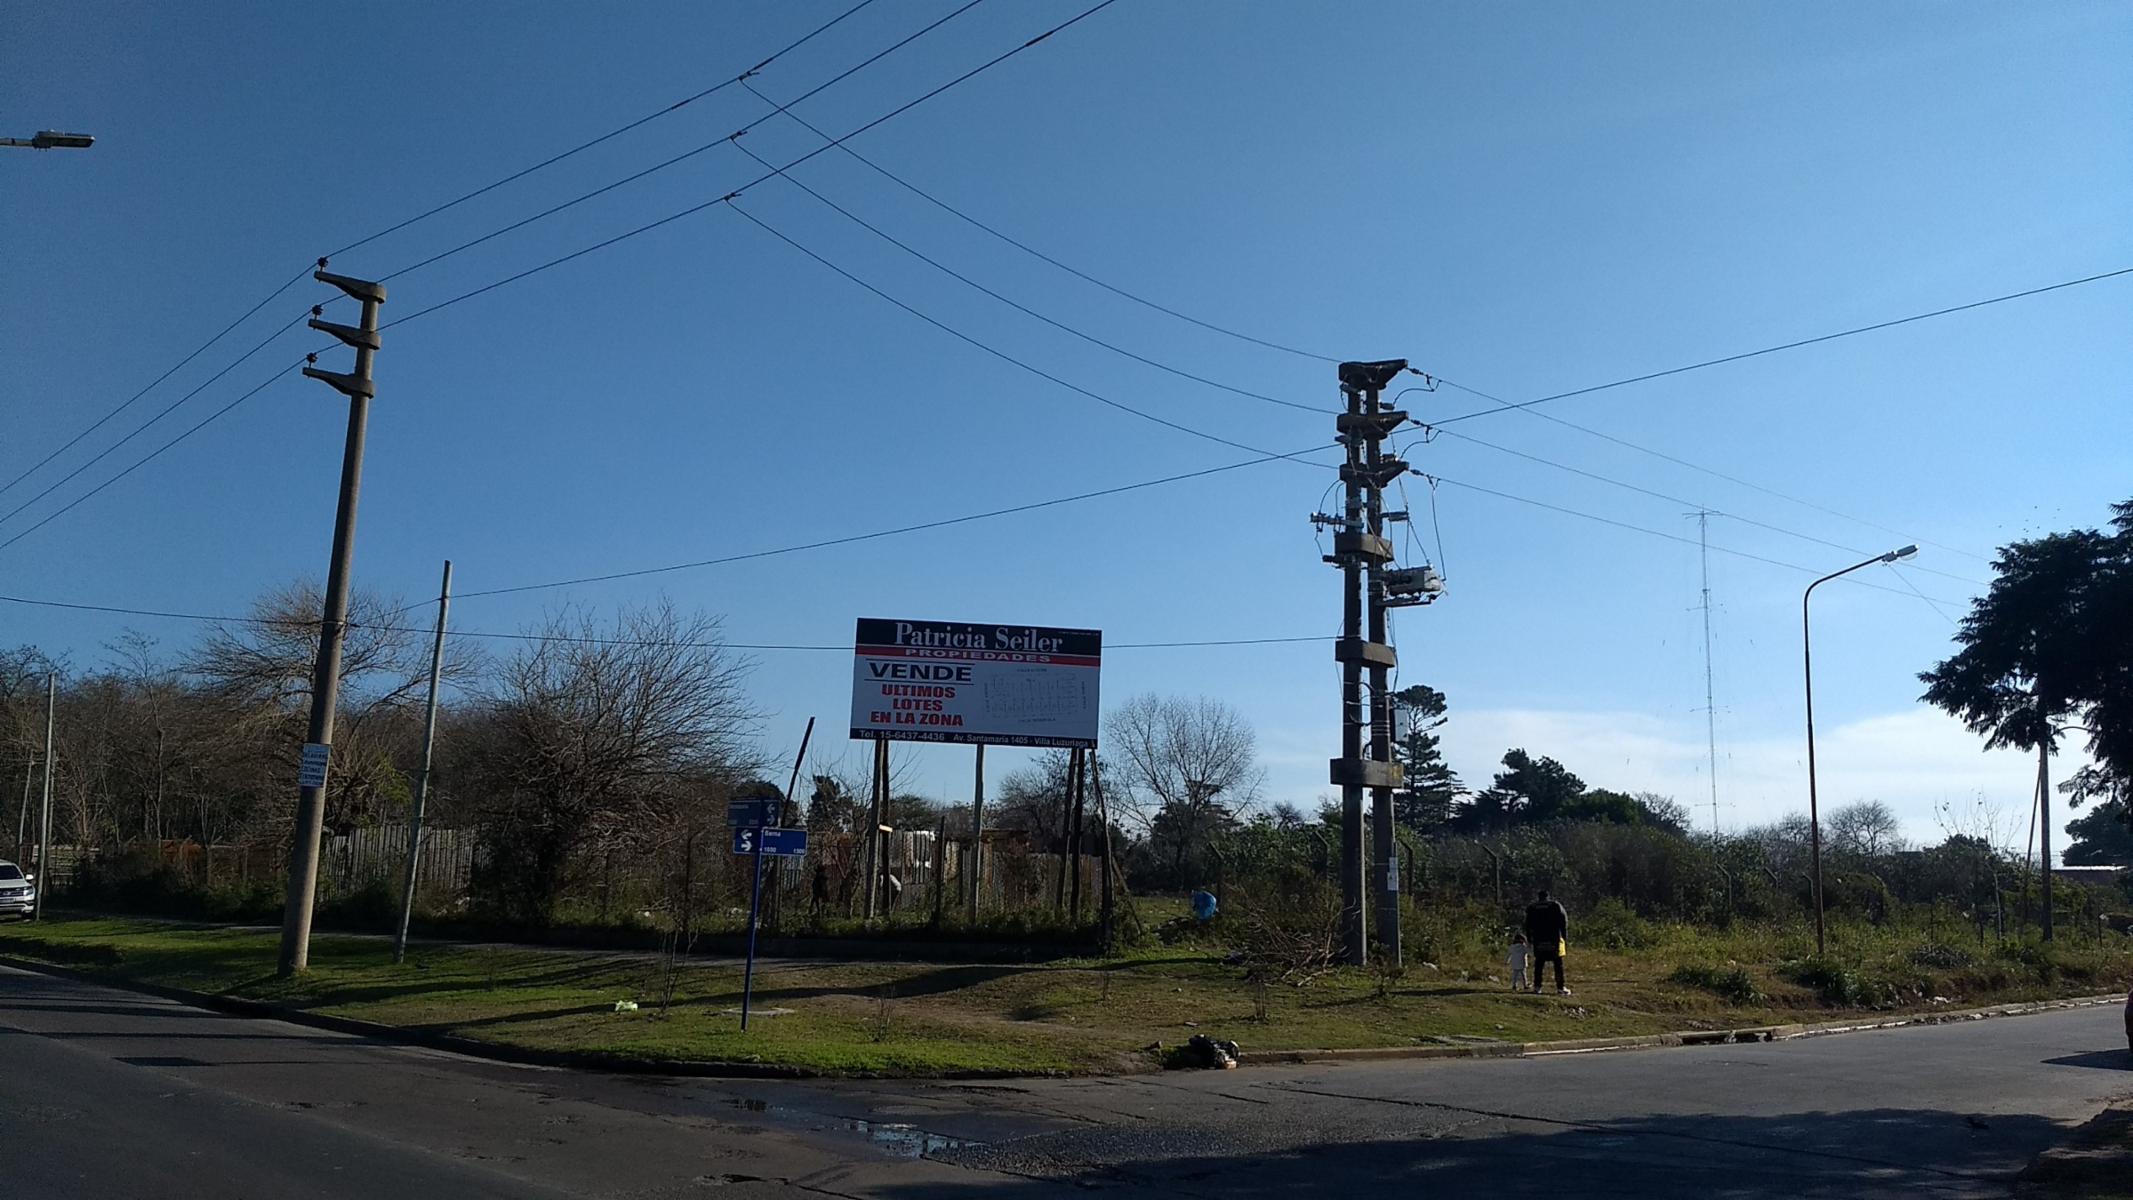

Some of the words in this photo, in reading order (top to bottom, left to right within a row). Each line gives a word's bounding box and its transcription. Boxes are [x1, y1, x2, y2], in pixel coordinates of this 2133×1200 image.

[894, 622, 986, 648] Patricia
[995, 628, 1063, 653] Seiler
[905, 648, 1051, 663] PROPIEDADES
[869, 663, 972, 682] VENDE
[881, 684, 956, 698] ULTIMOS
[893, 698, 943, 711] LOTES
[870, 711, 892, 724] EN
[896, 712, 916, 724] LA
[919, 713, 963, 726] ZONA
[880, 730, 945, 741] 15-6437-4436
[953, 734, 966, 742] Av.
[1011, 735, 1029, 744] 1405
[1034, 736, 1050, 746] Villa
